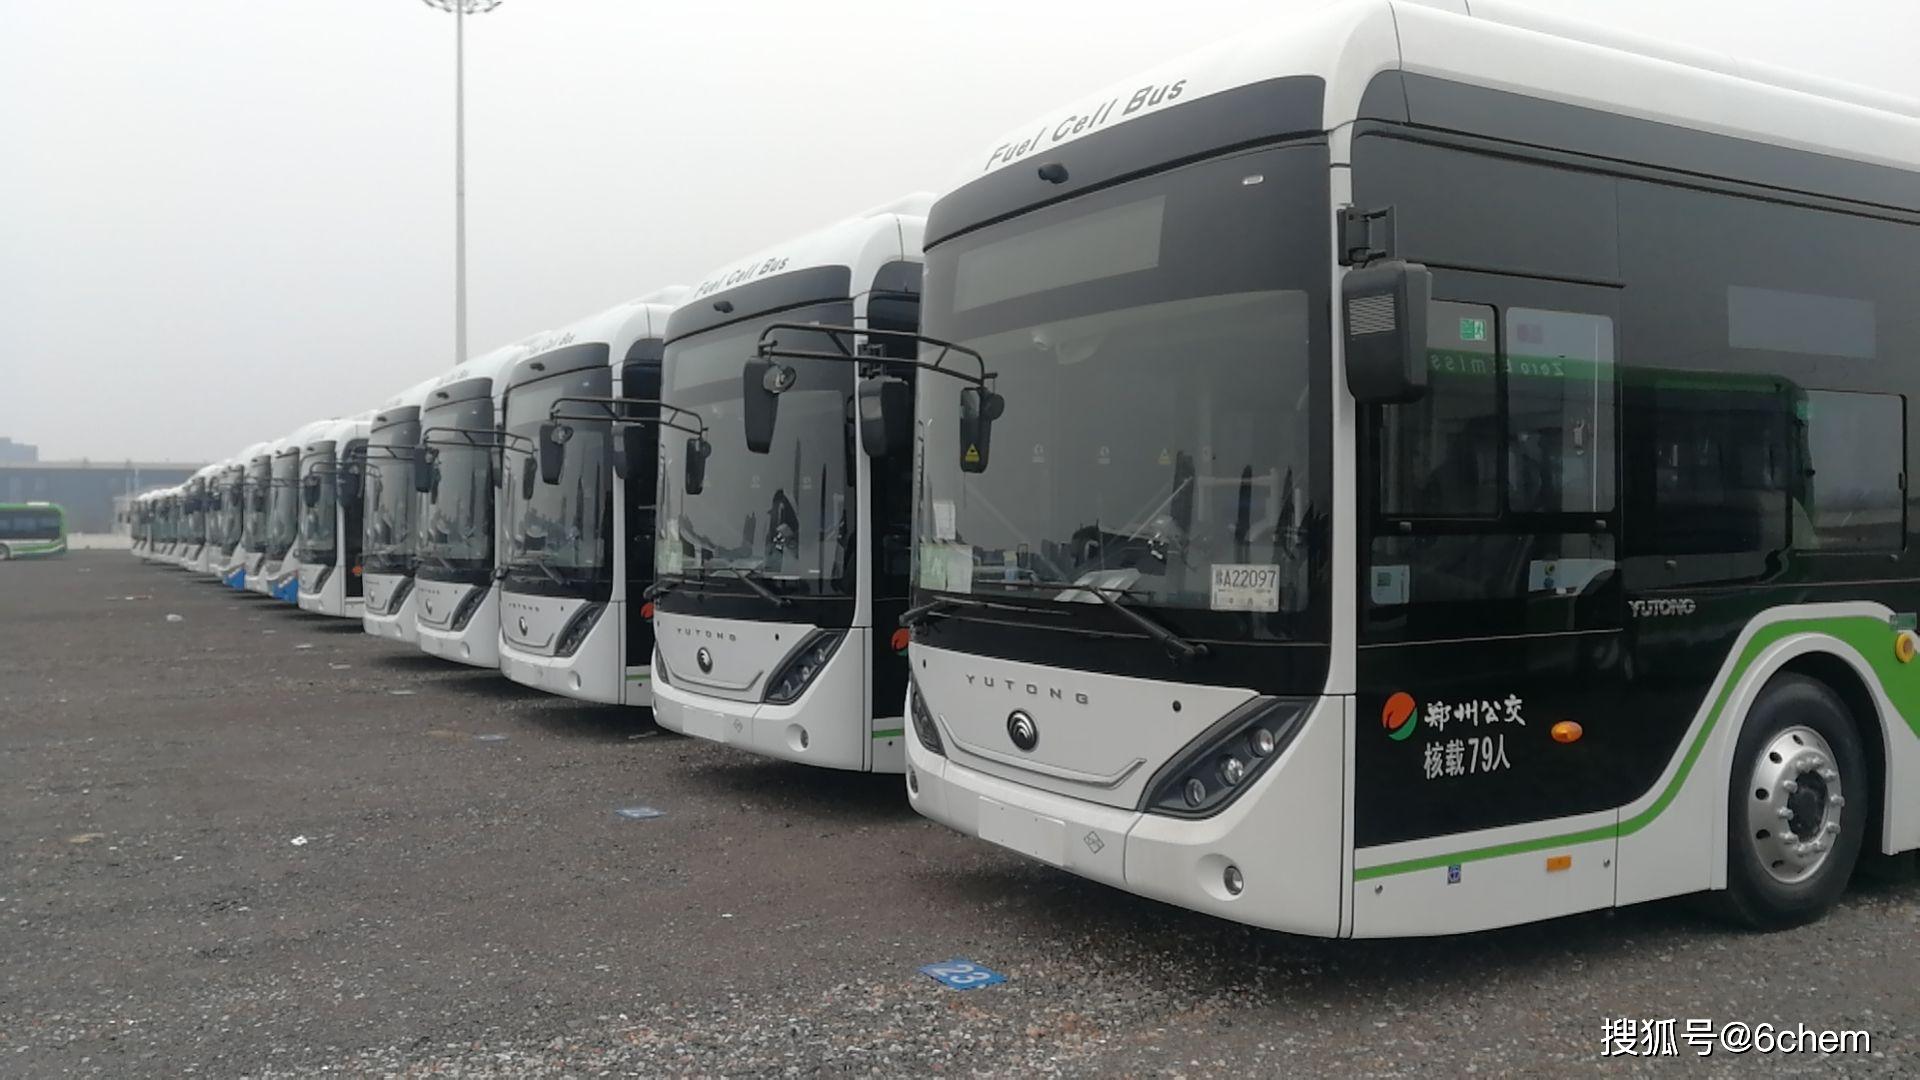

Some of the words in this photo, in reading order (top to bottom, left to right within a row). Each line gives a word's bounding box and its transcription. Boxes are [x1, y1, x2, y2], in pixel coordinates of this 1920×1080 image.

[984, 126, 1047, 171] Fuel
[1052, 98, 1118, 142] Cell
[1122, 79, 1187, 116] Bus
[758, 257, 789, 276] Bus
[1627, 598, 1697, 618] YUTONG
[677, 627, 737, 642] YUTONG
[965, 674, 1090, 705] YUTONG
[1424, 693, 1527, 732] 郑州公交
[1423, 733, 1511, 780] 核载79人
[931, 964, 991, 984] 23
